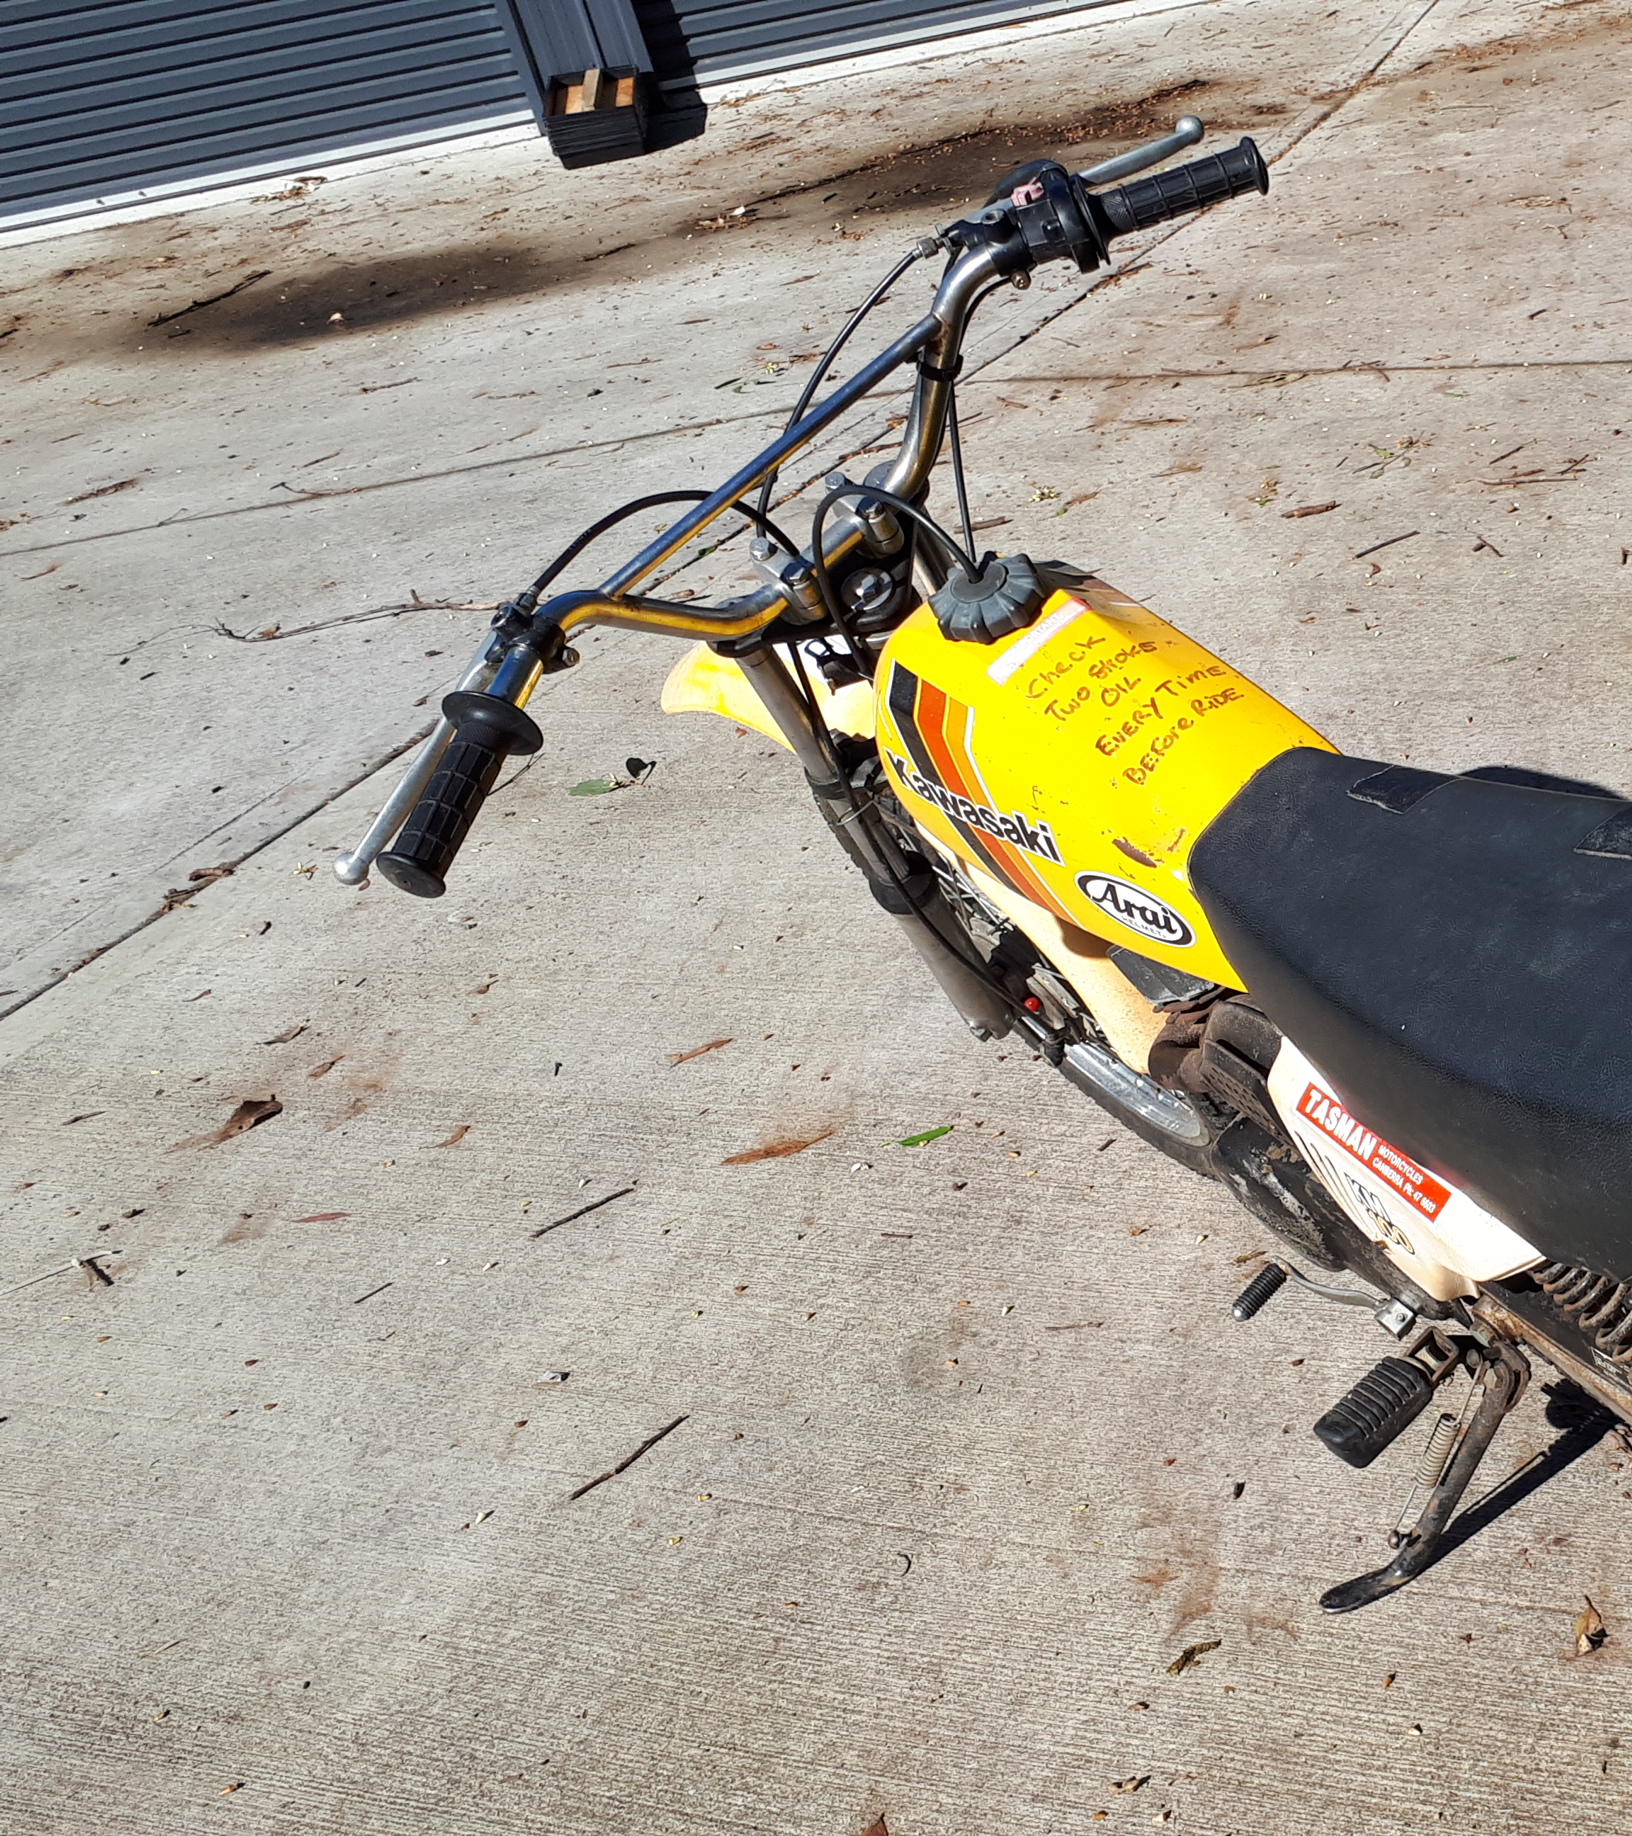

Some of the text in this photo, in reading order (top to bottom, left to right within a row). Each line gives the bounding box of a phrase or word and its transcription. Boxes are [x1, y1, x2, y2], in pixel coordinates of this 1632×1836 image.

[884, 748, 1061, 864] Kawasaki
[1092, 882, 1178, 934] Arai
[1304, 1089, 1379, 1160] TASMAN
[1372, 1157, 1405, 1188] CANBERRA
[1378, 1144, 1424, 1185] MOTORCYCLES
[1366, 1207, 1415, 1255] 100
